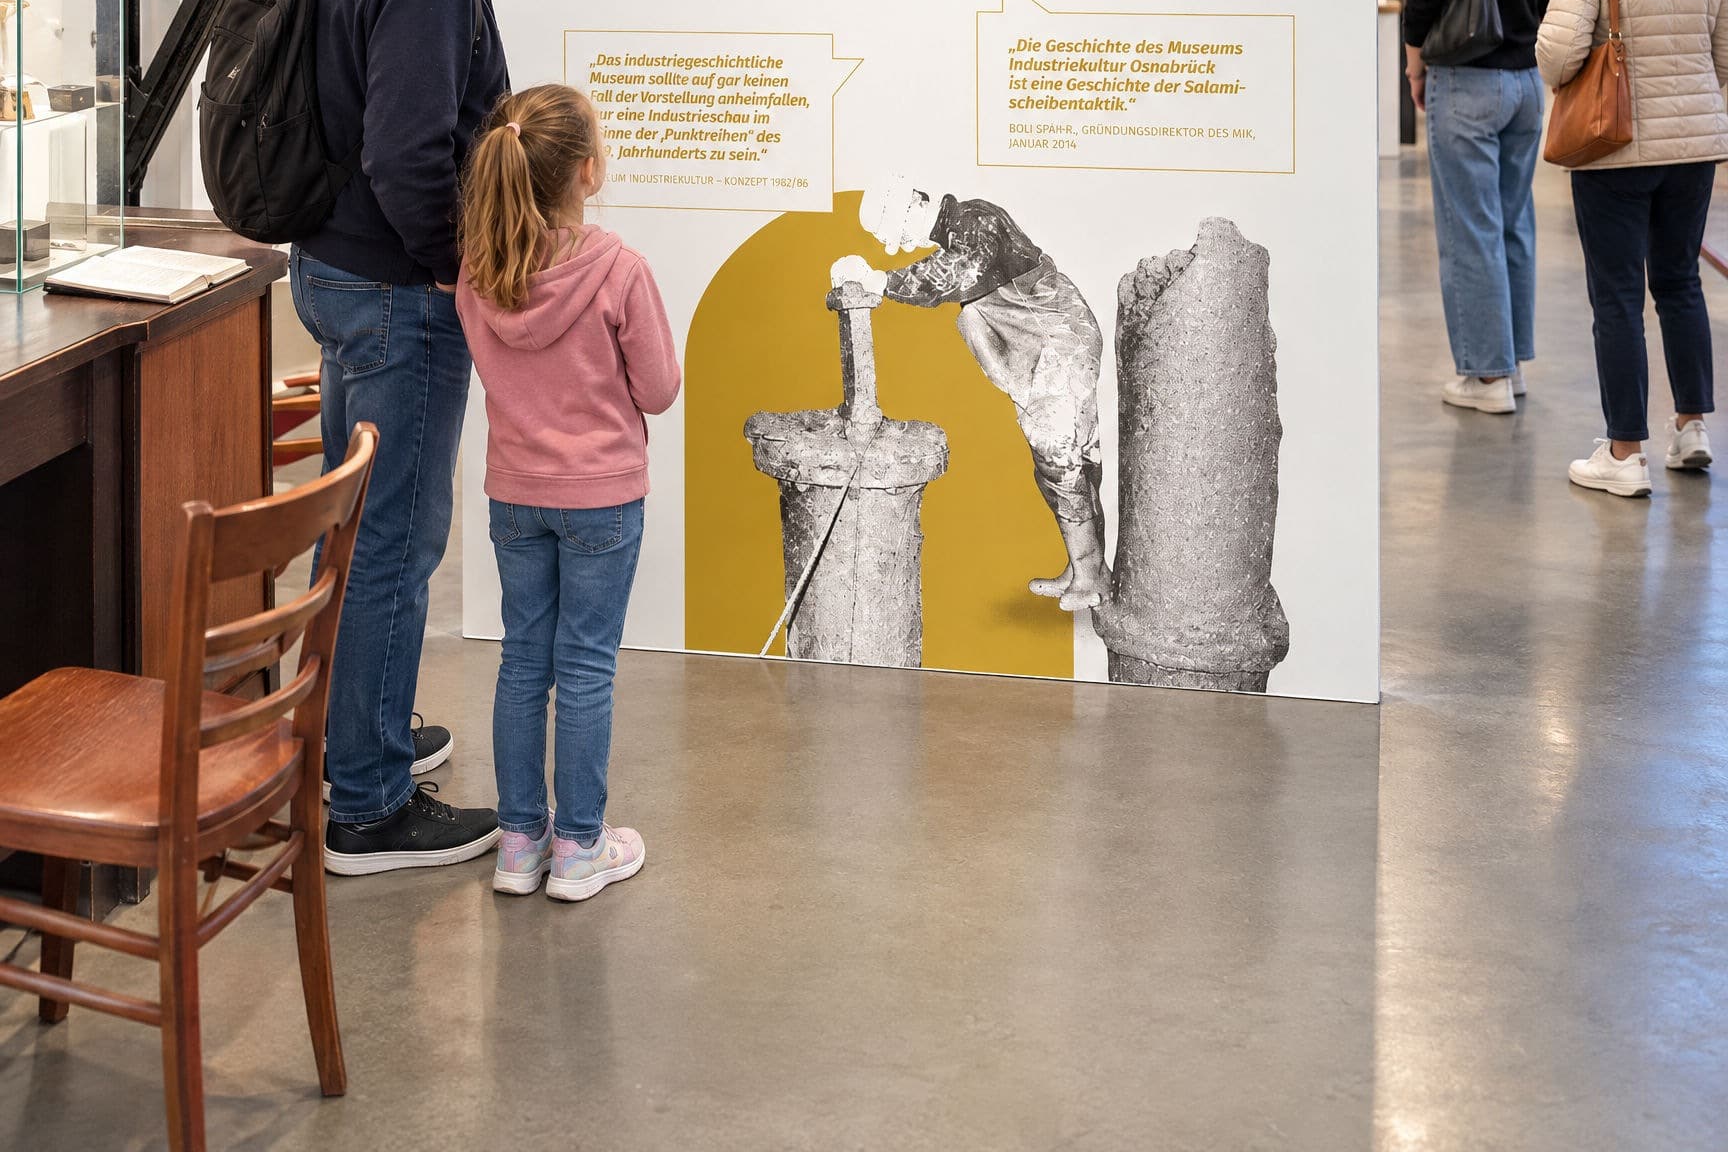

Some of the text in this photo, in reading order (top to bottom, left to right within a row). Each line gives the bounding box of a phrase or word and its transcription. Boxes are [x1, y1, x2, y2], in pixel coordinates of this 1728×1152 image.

[1007, 36, 1243, 55] „Die Geschichte des Museums
[589, 52, 783, 70] „Das industriegeschichtliche
[1008, 56, 1215, 74] Industriekultur Osnabrück
[589, 71, 645, 84] Museum
[691, 72, 716, 89] auf
[716, 76, 740, 89] gar
[743, 72, 788, 87] keinen
[1008, 74, 1246, 94] ist eine Geschichte der Salami-
[615, 89, 638, 103] der
[640, 90, 715, 107] Vorstellung
[717, 91, 809, 111] anheimfallen,
[1008, 94, 1136, 111] scheibentaktik.“
[616, 106, 644, 121] eine
[648, 108, 749, 123] Industrieschau
[753, 109, 769, 124] im
[635, 126, 658, 140] der
[755, 129, 781, 143] des
[1081, 123, 1204, 137] GRÜNDUNGSDIREKTOR
[1207, 127, 1229, 138] DES
[1232, 128, 1255, 140] MIK,
[1008, 138, 1076, 149] JANUAR 2014
[617, 145, 707, 159] Jahrhunderts
[709, 149, 725, 160] zu
[728, 147, 767, 161] sein.“
[629, 173, 713, 184] INDUSTRIEKULTUR
[724, 176, 768, 186] KONZEPT
